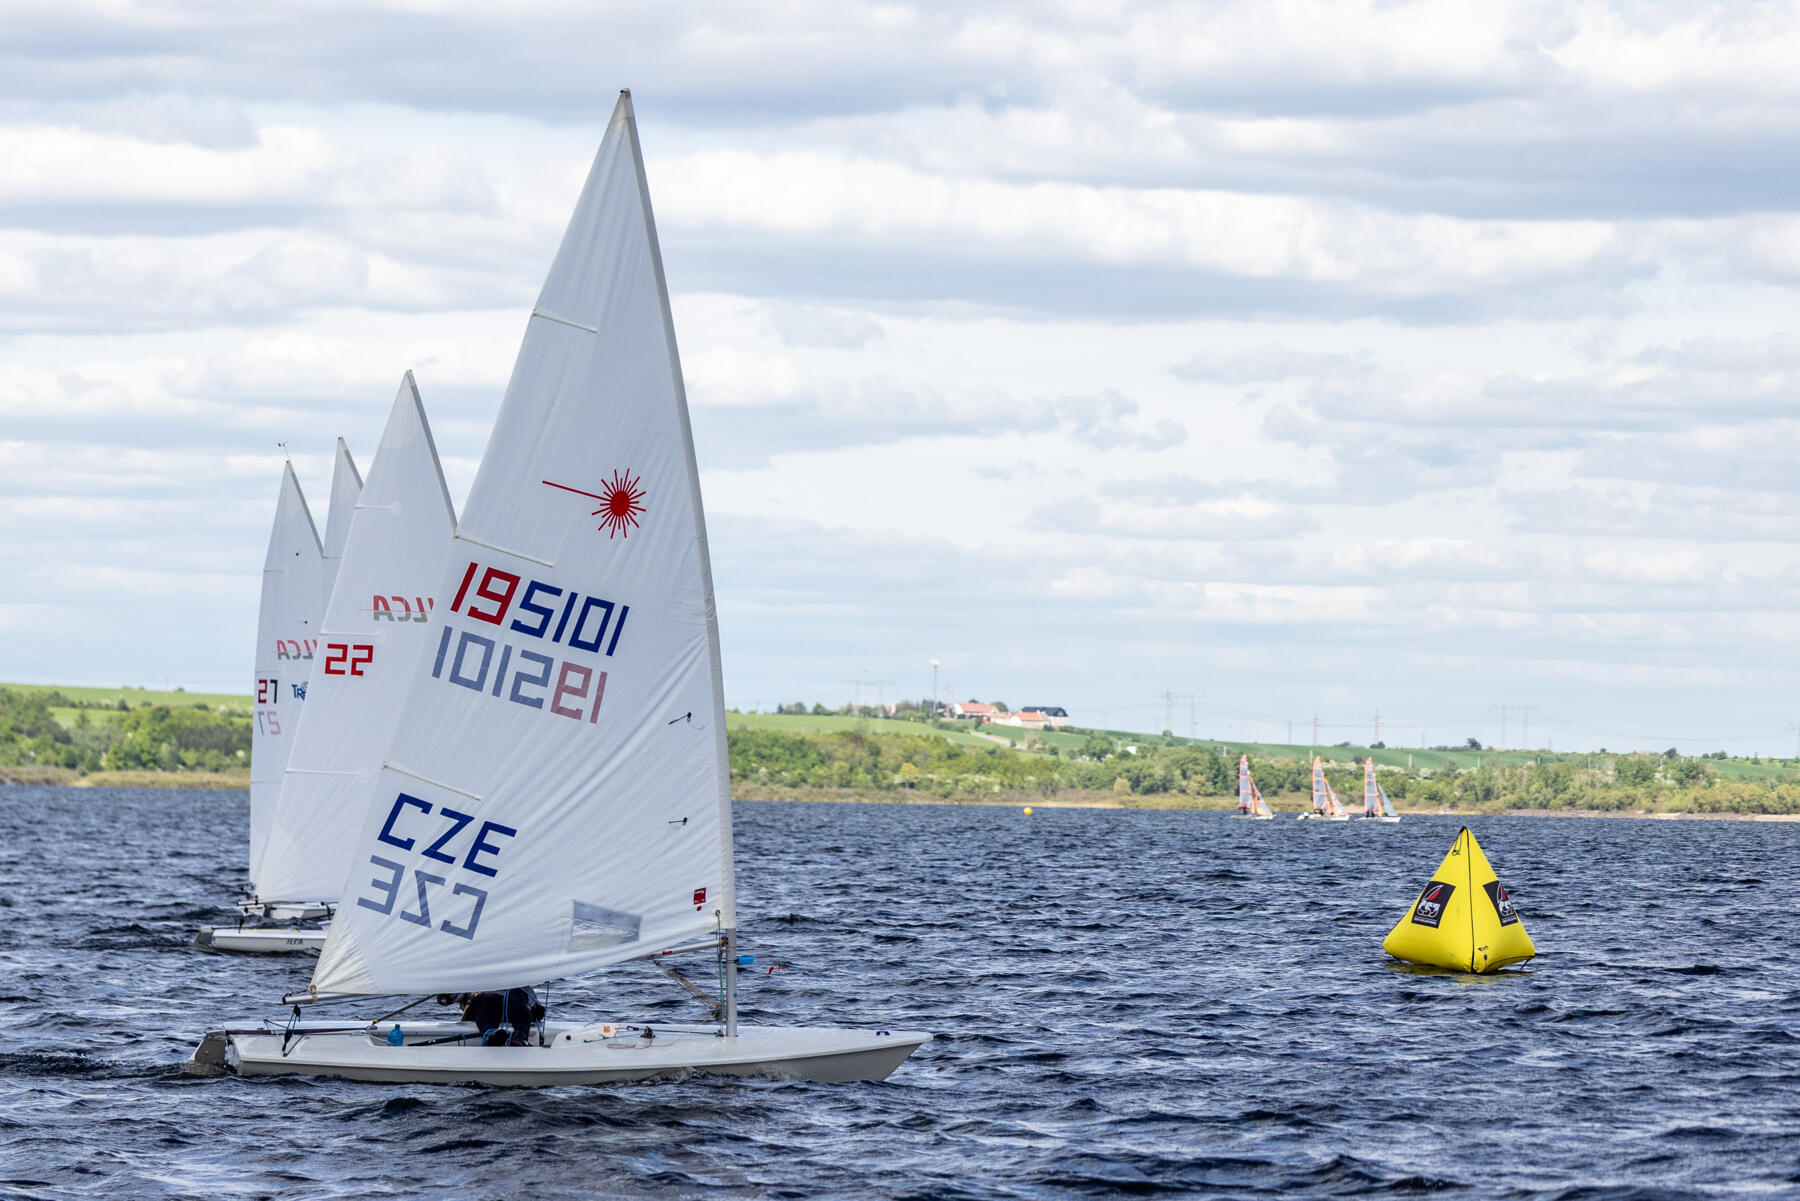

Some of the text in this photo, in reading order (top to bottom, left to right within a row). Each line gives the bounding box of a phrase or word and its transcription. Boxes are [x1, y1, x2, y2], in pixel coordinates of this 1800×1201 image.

[450, 561, 630, 657] 195101
[325, 643, 374, 676] 22
[258, 679, 278, 704] 27
[377, 792, 518, 878] CZE
